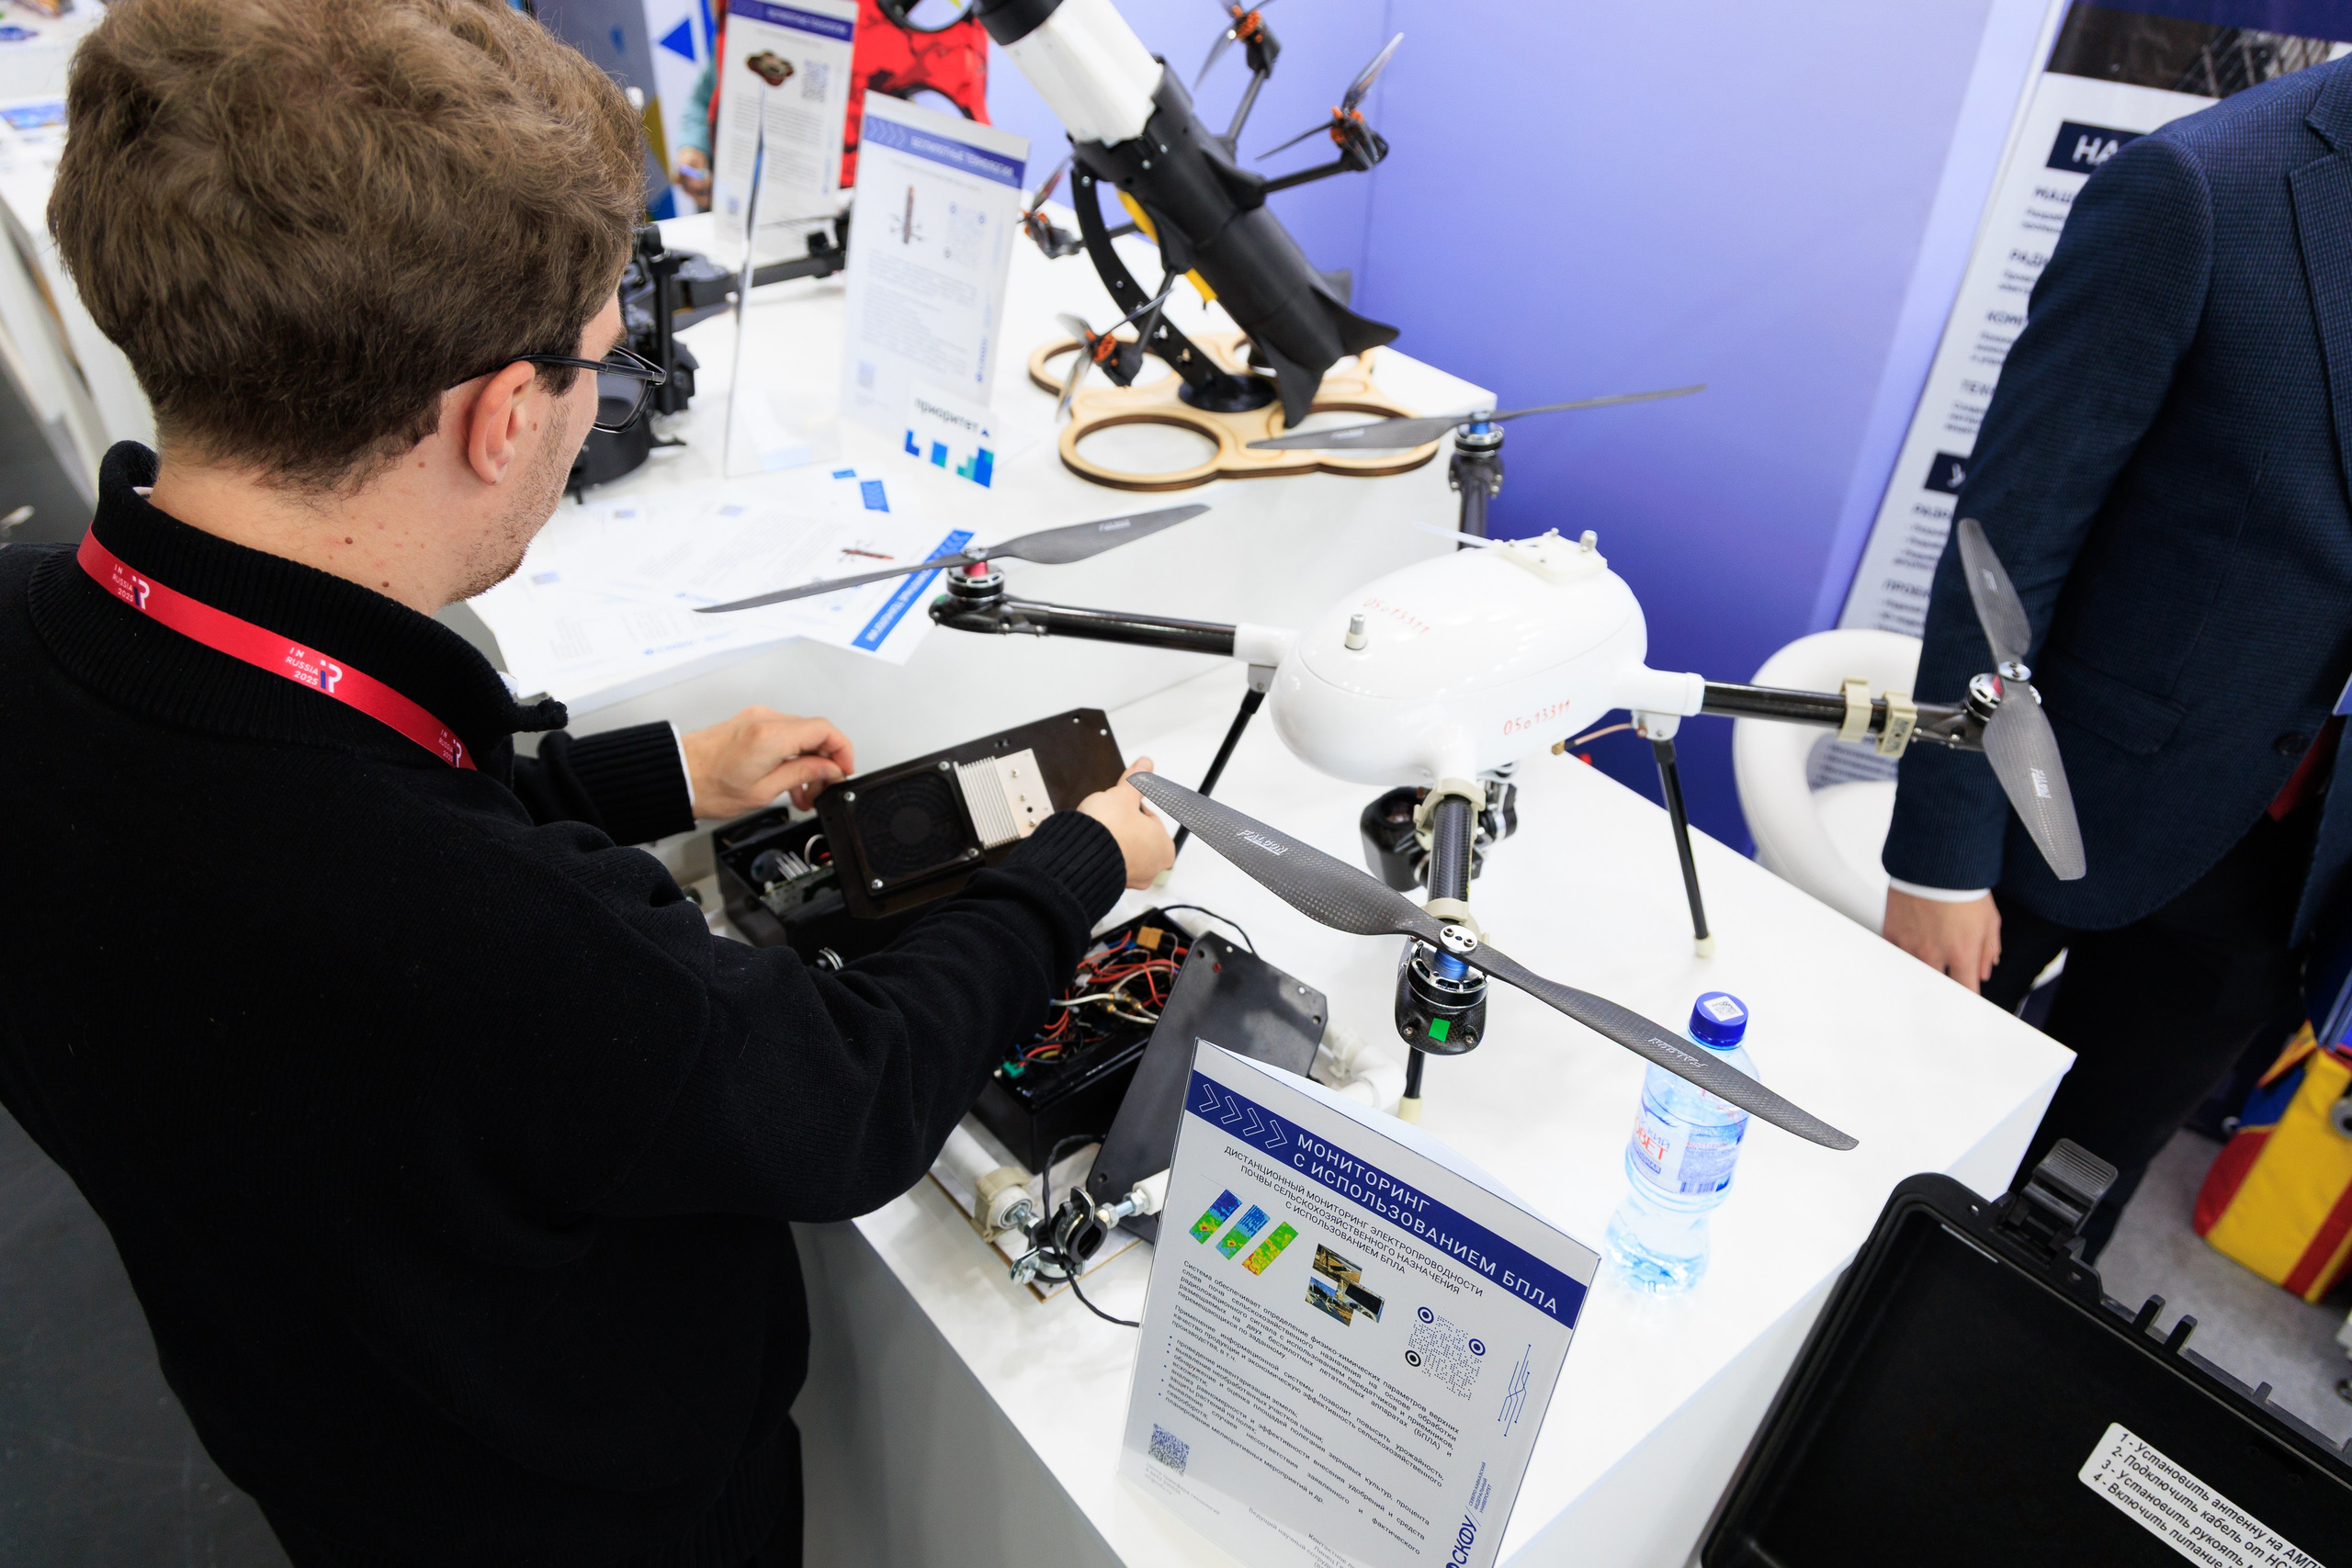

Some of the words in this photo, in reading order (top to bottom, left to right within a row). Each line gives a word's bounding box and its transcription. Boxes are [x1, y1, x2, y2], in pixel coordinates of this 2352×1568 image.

[112, 573, 133, 592] RUSSIA
[118, 587, 134, 603] 2025
[285, 656, 319, 676] RUSSIA
[289, 647, 305, 659] IN
[293, 670, 319, 686] 2025
[1223, 1145, 1306, 1195] ДИСТАНЦИОННЫЙ
[1306, 1190, 1369, 1229] МОНИТОРИНГ
[1370, 1225, 1483, 1297] ЭЛЕКТРОПРОВОДНОСТИ
[1297, 1133, 1430, 1213] МОНИТОРИНГ
[1240, 1165, 1272, 1188] ПОЧВЫ
[1273, 1183, 1396, 1257] СЕЛЬСКОХОЗЯЙСТВЕННОГО
[1396, 1252, 1460, 1295] НАЗНАЧЕНИЯ
[1284, 1201, 1292, 1209] С
[1293, 1204, 1379, 1258] ИСПОЛЬЗОВАНИЕМ
[1380, 1253, 1405, 1274] БПЛА
[1293, 1152, 1306, 1168] С
[1310, 1161, 1497, 1276] ИСПОЛЬЗОВАНИЕМ
[1501, 1269, 1556, 1314] БПЛА
[1172, 1313, 1204, 1334] качество
[1204, 1331, 1240, 1356] продукции
[1174, 1304, 1216, 1333] Применение
[1283, 1371, 1315, 1393] системы
[1318, 1393, 1351, 1416] позволит
[1355, 1416, 1391, 1443] повысить
[1178, 1283, 1227, 1314] размещаемых
[1231, 1314, 1241, 1324] на
[1245, 1323, 1262, 1336] двух
[1267, 1335, 1314, 1367] беспилотных
[1318, 1367, 1365, 1399] летательных
[1370, 1400, 1408, 1427] аппаратах
[1413, 1427, 1441, 1450] (БПЛА)
[1182, 1269, 1202, 1283] слоев
[1207, 1283, 1225, 1297] почв
[1319, 1350, 1362, 1380] назначения
[1368, 1380, 1378, 1390] на
[1384, 1391, 1411, 1411] основе
[1417, 1413, 1457, 1442] обработки
[1183, 1259, 1213, 1281] Система
[1262, 1307, 1309, 1338] определение
[1382, 1381, 1427, 1413] параметров
[1428, 1410, 1460, 1435] верхних
[1226, 1352, 1237, 1362] т.ч.
[1238, 1326, 1248, 1336] по
[1248, 1332, 1288, 1359] заданному.
[1249, 1316, 1277, 1337] сигнала
[1407, 1415, 1453, 1450] приемников,
[2093, 1472, 2103, 1482] 4
[2107, 1482, 2167, 1531] Включить
[2169, 1528, 2223, 1568] питание
[2101, 1460, 2111, 1470] 3
[2116, 1470, 2191, 1529] Установить
[2191, 1524, 2245, 1567] рукоять
[2120, 1433, 2129, 1442] 1
[2134, 1442, 2210, 1501] Установить
[2211, 1498, 2267, 1540] антенну
[2266, 1537, 2283, 1551] на
[2283, 1548, 2324, 1568] АМП
[2123, 1454, 2199, 1513] Подключить
[2199, 1510, 2242, 1543] кабель
[2245, 1541, 2265, 1558] от
[2265, 1553, 2292, 1568] НС
